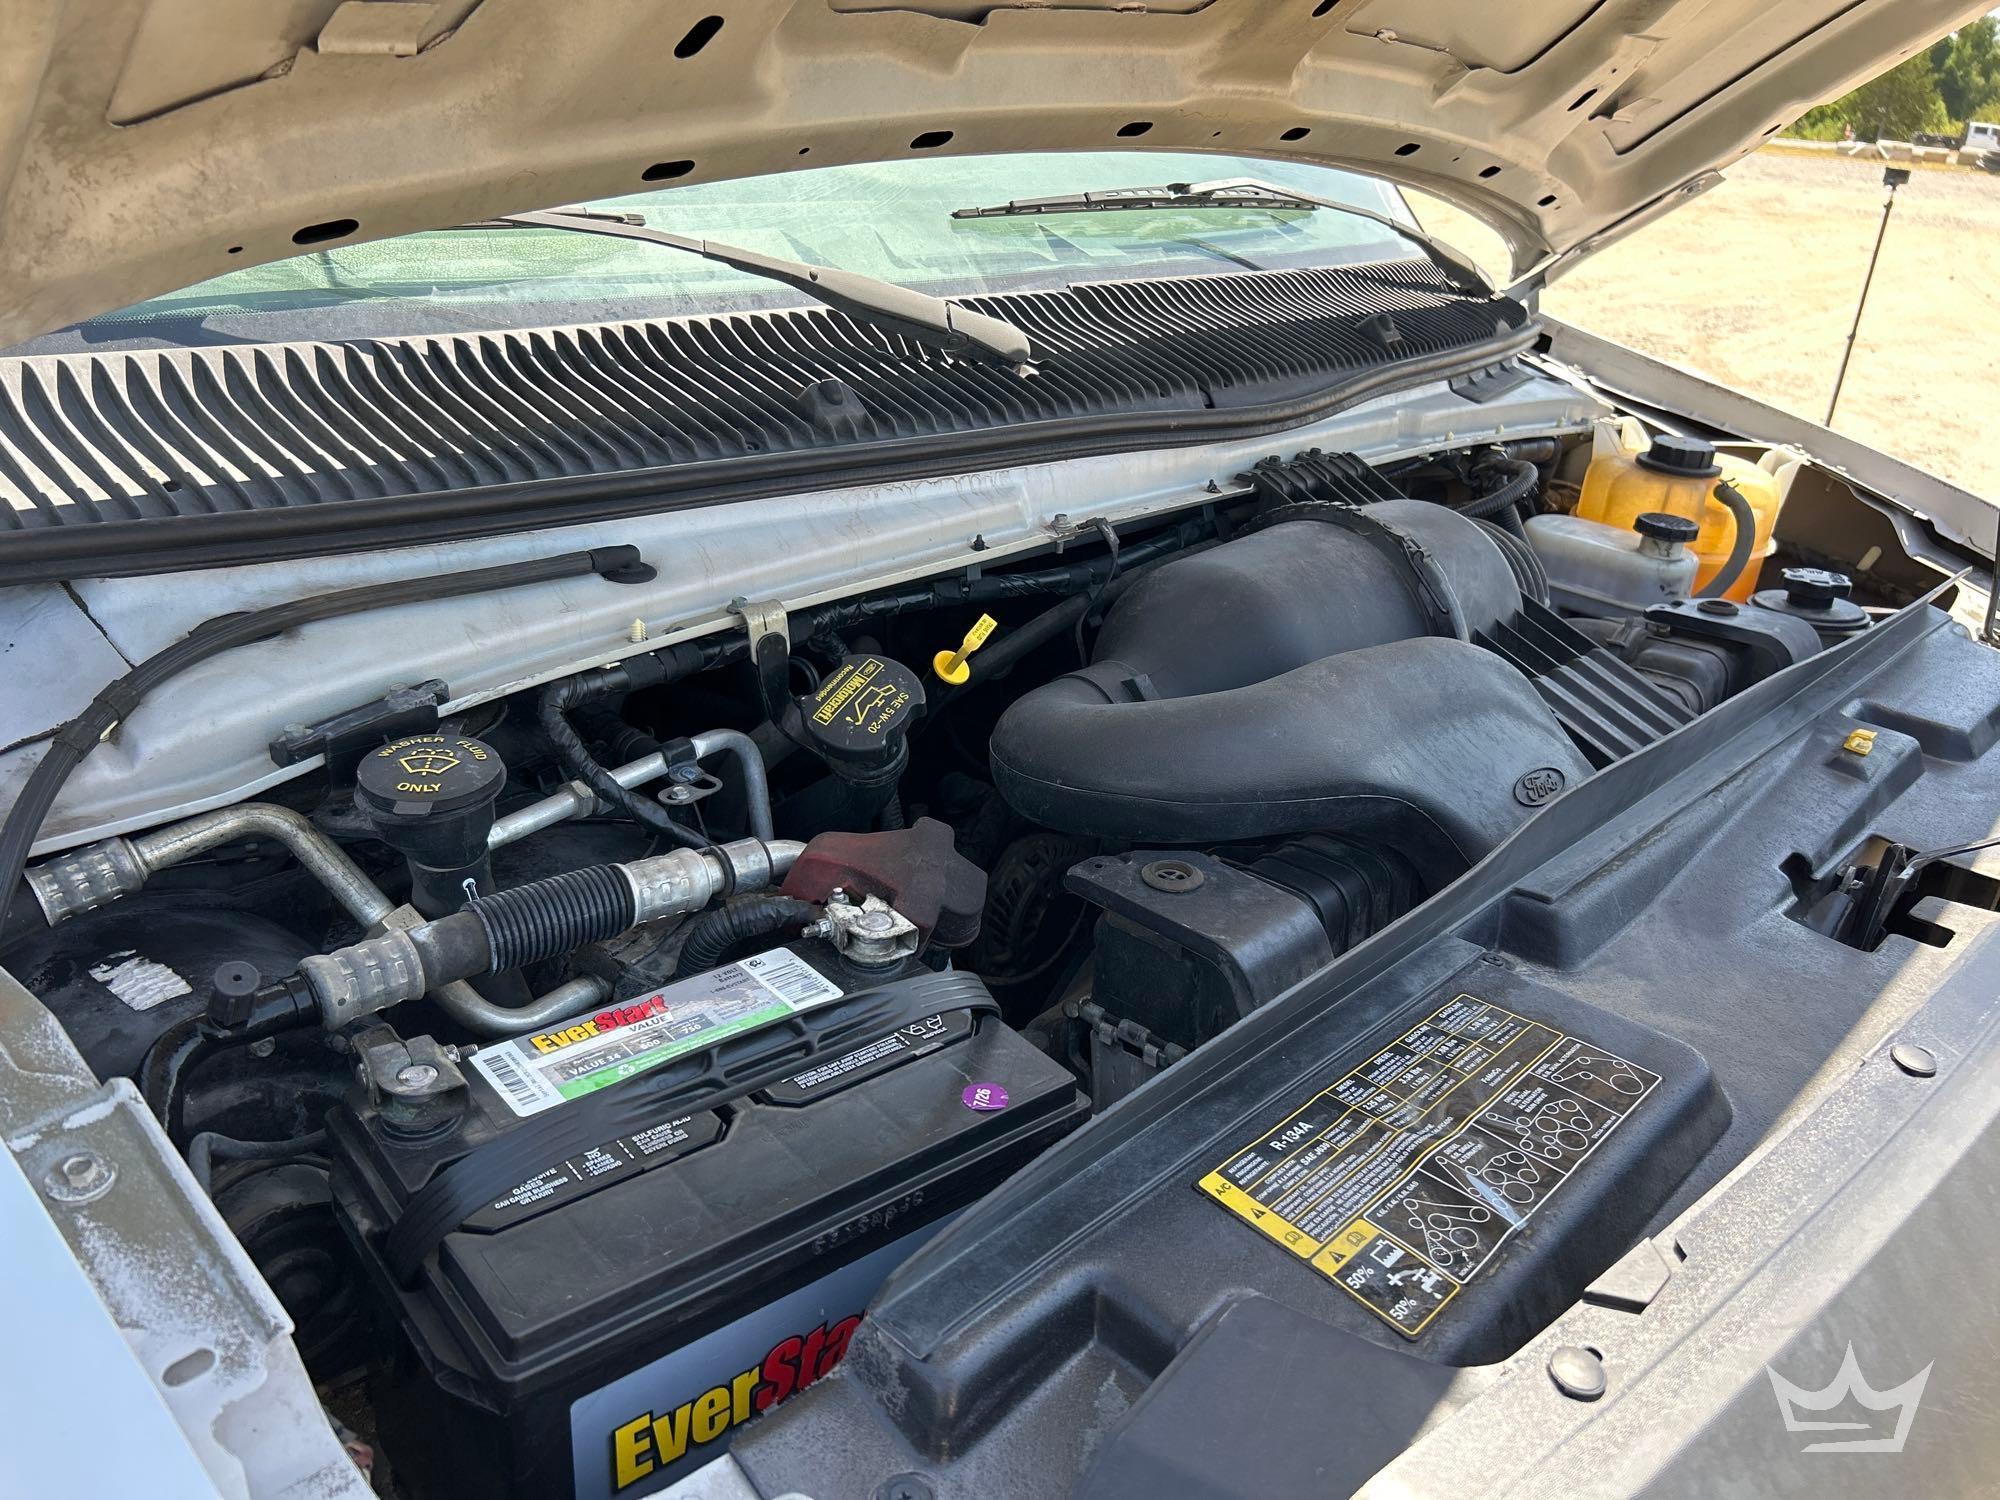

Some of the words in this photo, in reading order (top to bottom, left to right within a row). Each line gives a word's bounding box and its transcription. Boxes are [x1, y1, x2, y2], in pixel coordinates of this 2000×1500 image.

[816, 664, 854, 702] Recommended
[818, 675, 866, 720] Motorcraft
[891, 692, 909, 709] SAE
[867, 707, 896, 734] 5W-20
[377, 736, 445, 758] WASHER
[456, 740, 488, 761] FLUID
[396, 782, 442, 793] ONLY
[1523, 773, 1558, 802] Ford
[528, 993, 669, 1055] EverStart
[629, 1015, 665, 1031] VALUE
[680, 1023, 701, 1033] 750
[1404, 1025, 1430, 1042] GASOLINE
[568, 1058, 605, 1074] VALUE
[606, 1052, 620, 1061] 34
[1373, 1051, 1393, 1064] DIESEL
[1398, 1072, 1413, 1083] 3.38
[1409, 1066, 1422, 1075] lbs
[1480, 1067, 1501, 1083] FoMoCo
[1534, 1063, 1550, 1074] DIESEL
[1336, 1079, 1354, 1091] DIESEL
[973, 1088, 991, 1107] 7/26
[1362, 1099, 1378, 1109] 2.25
[1373, 1093, 1387, 1102] lbs
[1503, 1090, 1519, 1102] DIESEL
[1517, 1089, 1531, 1099] DUAL
[1518, 1087, 1543, 1108] ALTERNATOR
[1524, 1102, 1536, 1112] MAIN
[1533, 1092, 1547, 1104] DRIVE
[632, 1124, 671, 1142] SULFURIC
[636, 1137, 650, 1146] CAN
[650, 1130, 673, 1142] CAUSE
[1270, 1122, 1312, 1149] R-134A
[587, 1151, 601, 1160] NO
[1300, 1152, 1316, 1165] SAE
[1314, 1142, 1330, 1155] J639
[1443, 1143, 1460, 1154] DIESEL
[1458, 1141, 1474, 1153] SINGLE
[1458, 1143, 1483, 1163] ALTERNATOR
[585, 1154, 612, 1167] SPARKS
[588, 1158, 615, 1172] FLAMES
[592, 1161, 623, 1176] SMOKING
[495, 1199, 511, 1209] CAN
[510, 1191, 532, 1205] CAUSE
[532, 1177, 569, 1195] BLINDNESS
[512, 1180, 543, 1195] GASES
[1215, 1182, 1231, 1195] A/C
[1406, 1180, 1418, 1190] GAS
[1346, 1266, 1373, 1288] 50%
[1389, 1297, 1416, 1319] 50%
[613, 1311, 868, 1490] EverSta
